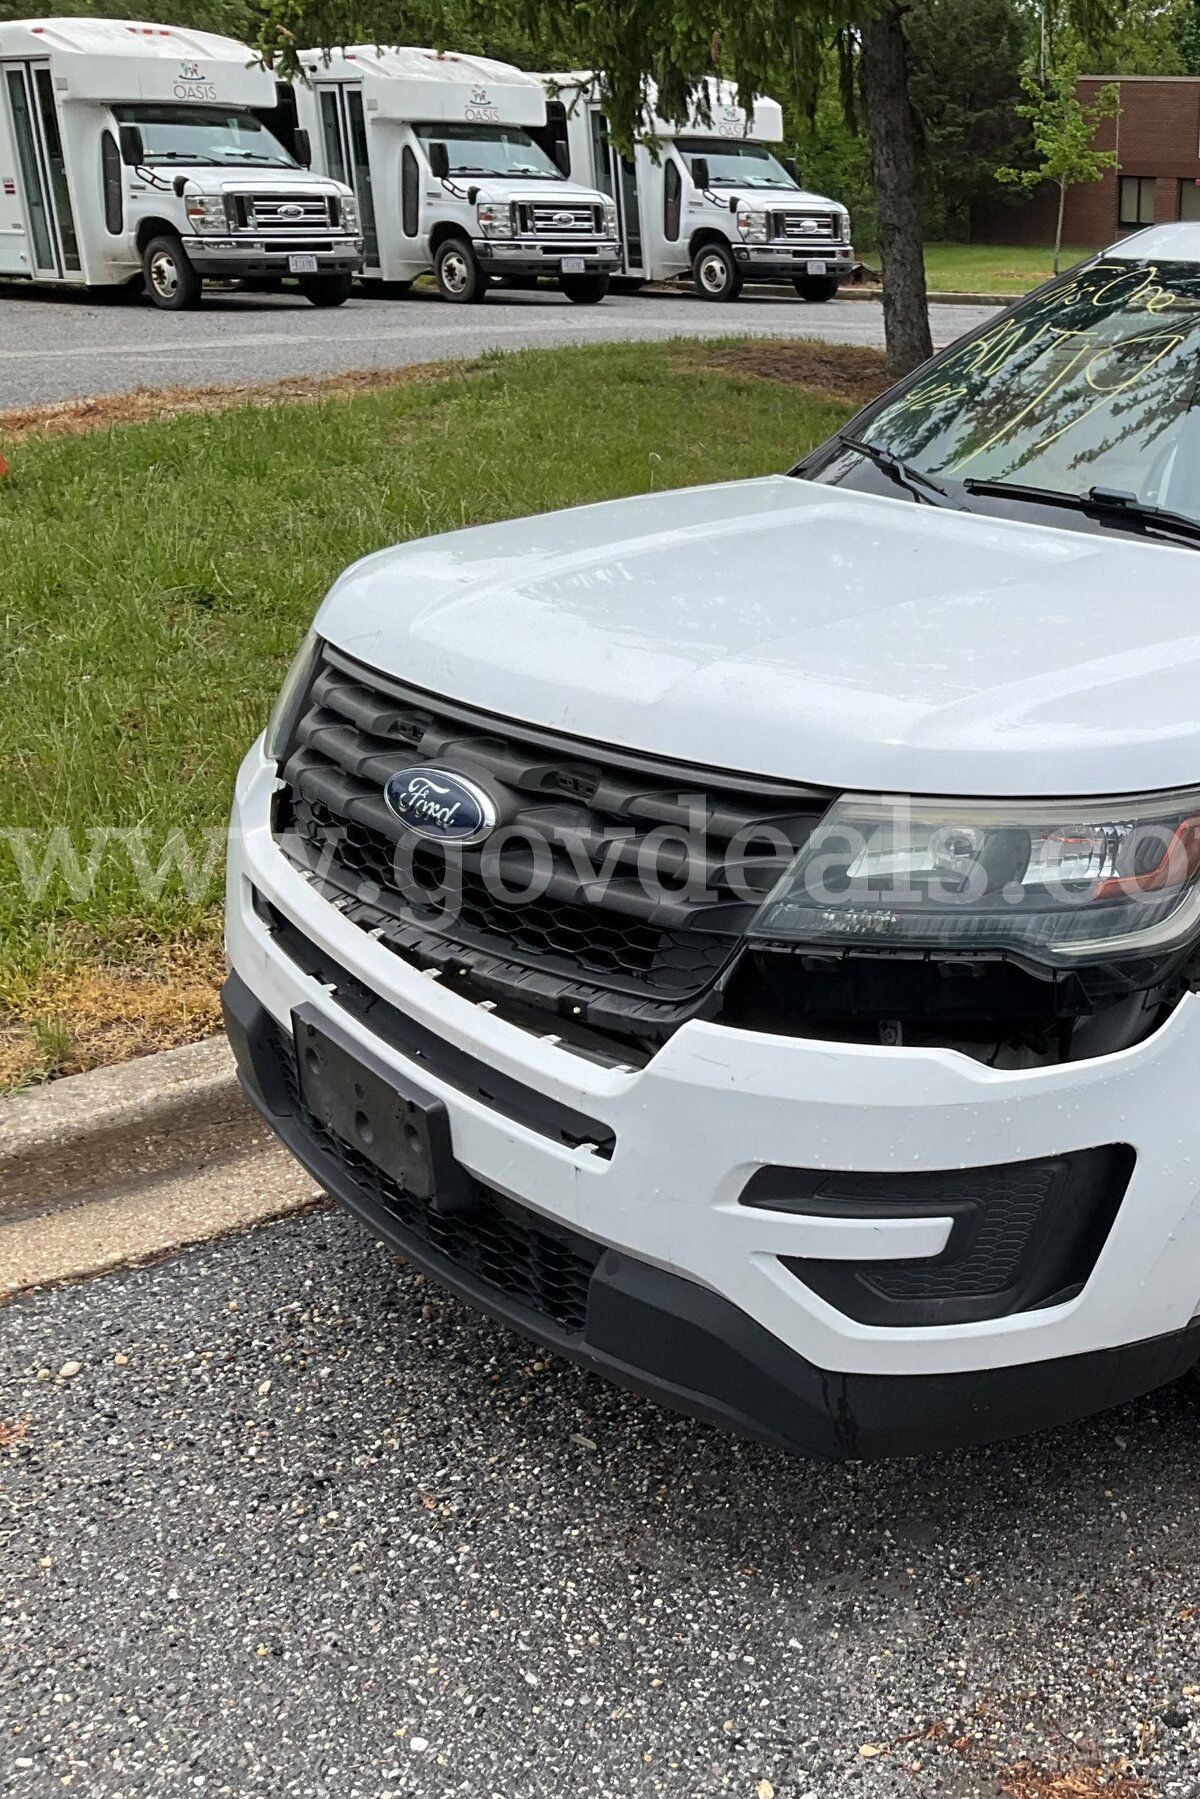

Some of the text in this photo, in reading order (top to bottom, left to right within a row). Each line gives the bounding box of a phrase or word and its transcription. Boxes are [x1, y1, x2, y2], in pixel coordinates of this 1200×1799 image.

[173, 84, 217, 100] OASIS
[464, 108, 500, 123] OASIS
[1093, 266, 1176, 315] One
[399, 777, 461, 828] Ford
